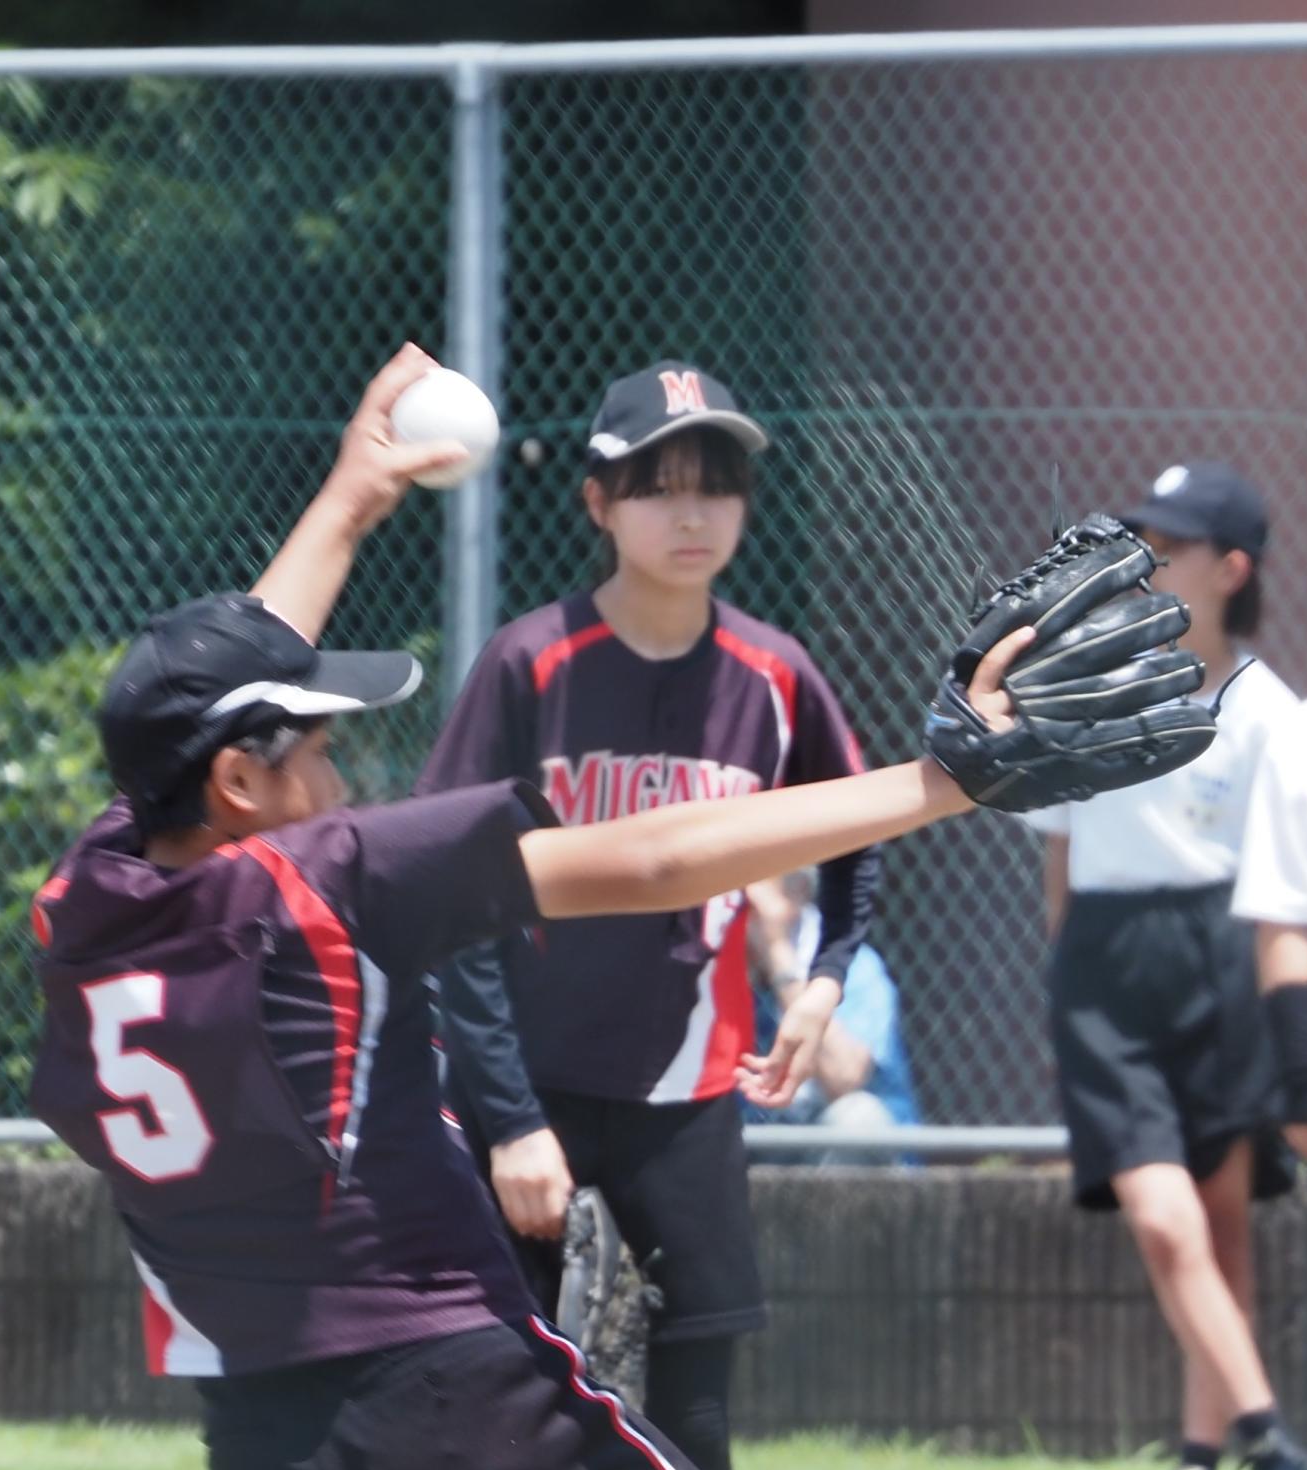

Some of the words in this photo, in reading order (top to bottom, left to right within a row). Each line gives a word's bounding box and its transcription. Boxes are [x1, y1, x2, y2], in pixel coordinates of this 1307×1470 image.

[658, 370, 707, 415] M
[541, 749, 762, 827] MIGAW
[78, 970, 214, 1184] 5
